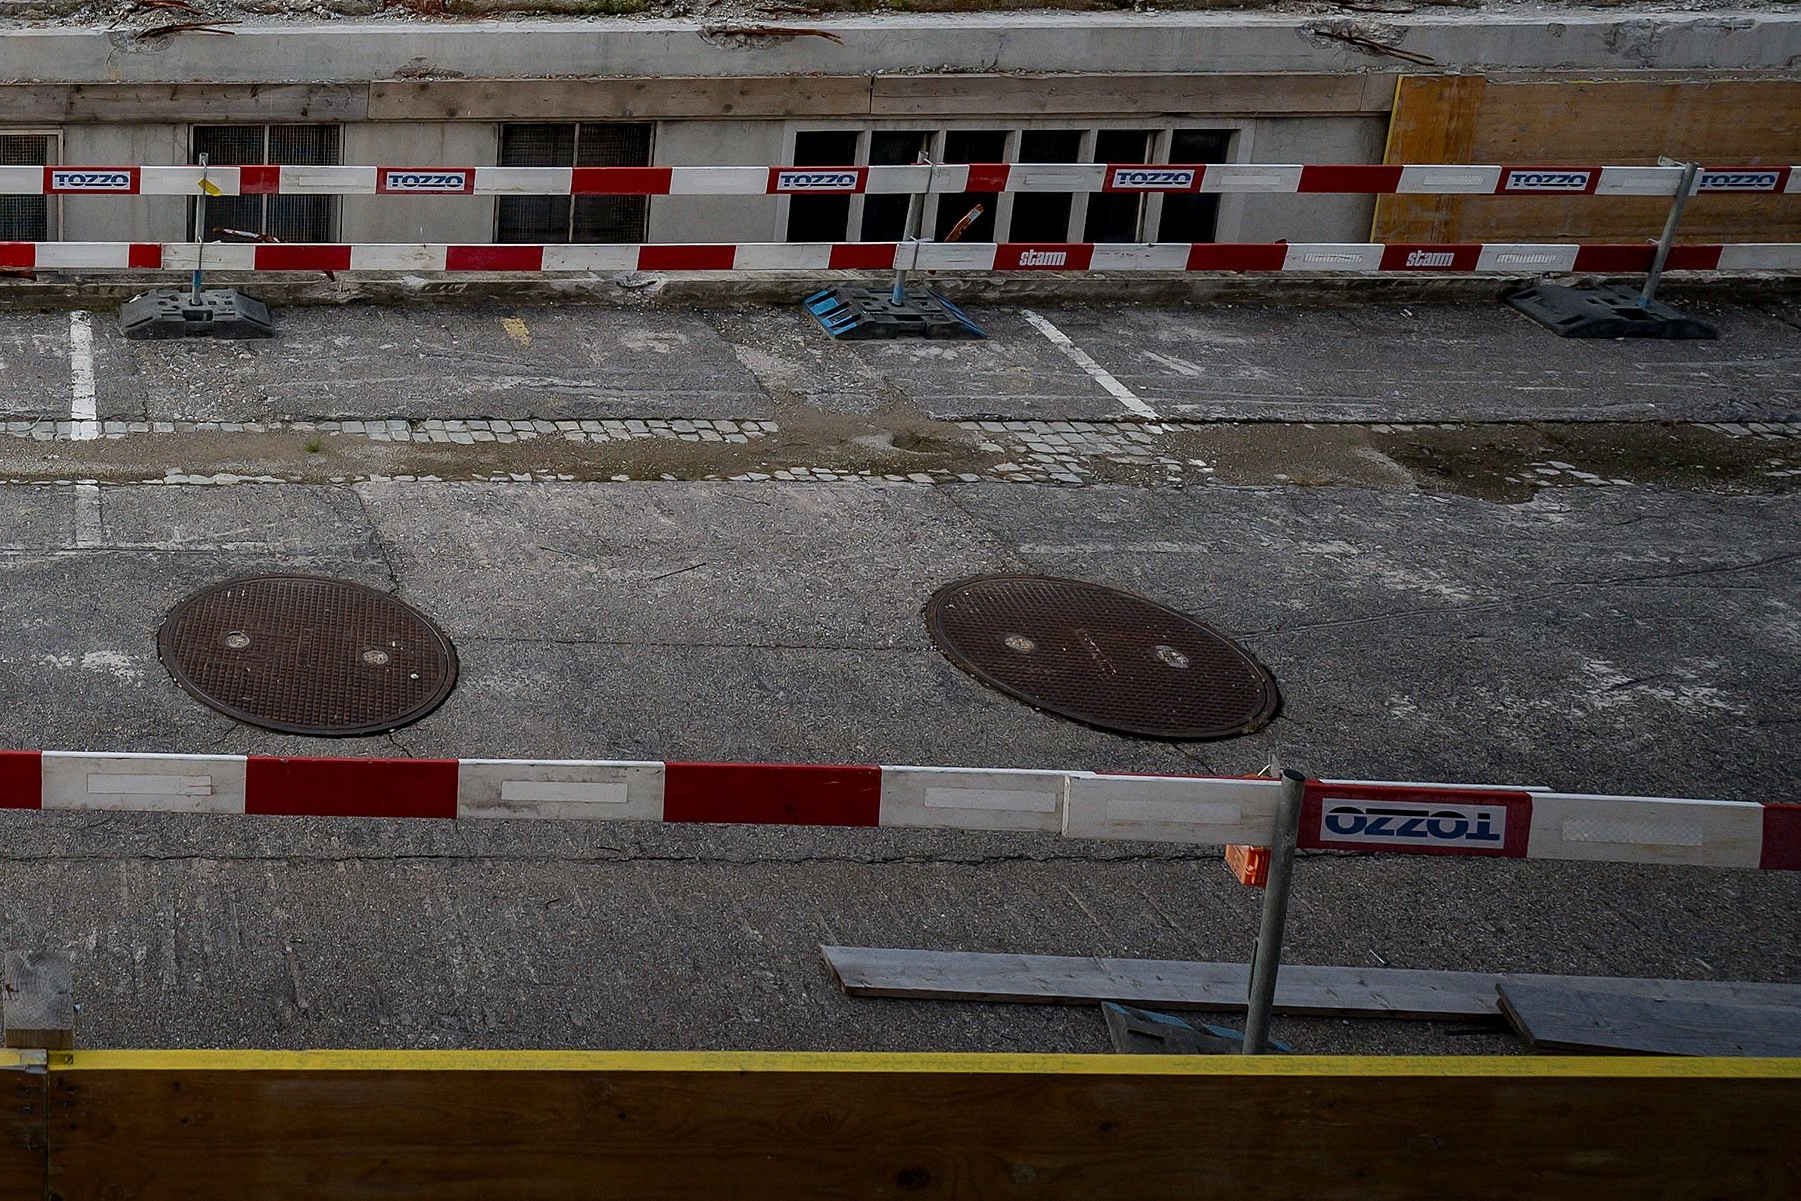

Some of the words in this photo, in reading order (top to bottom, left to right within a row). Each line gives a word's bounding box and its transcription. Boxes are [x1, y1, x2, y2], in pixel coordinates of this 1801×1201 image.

[54, 174, 129, 187] TOZZO
[389, 175, 464, 188] TOZZO
[781, 174, 856, 187] TOZZO
[1117, 172, 1192, 185] TOZZO
[1512, 174, 1588, 188] TOZZO
[1019, 249, 1067, 266] stamm
[1405, 250, 1455, 267] stamm
[1325, 806, 1500, 840] TOZZO
